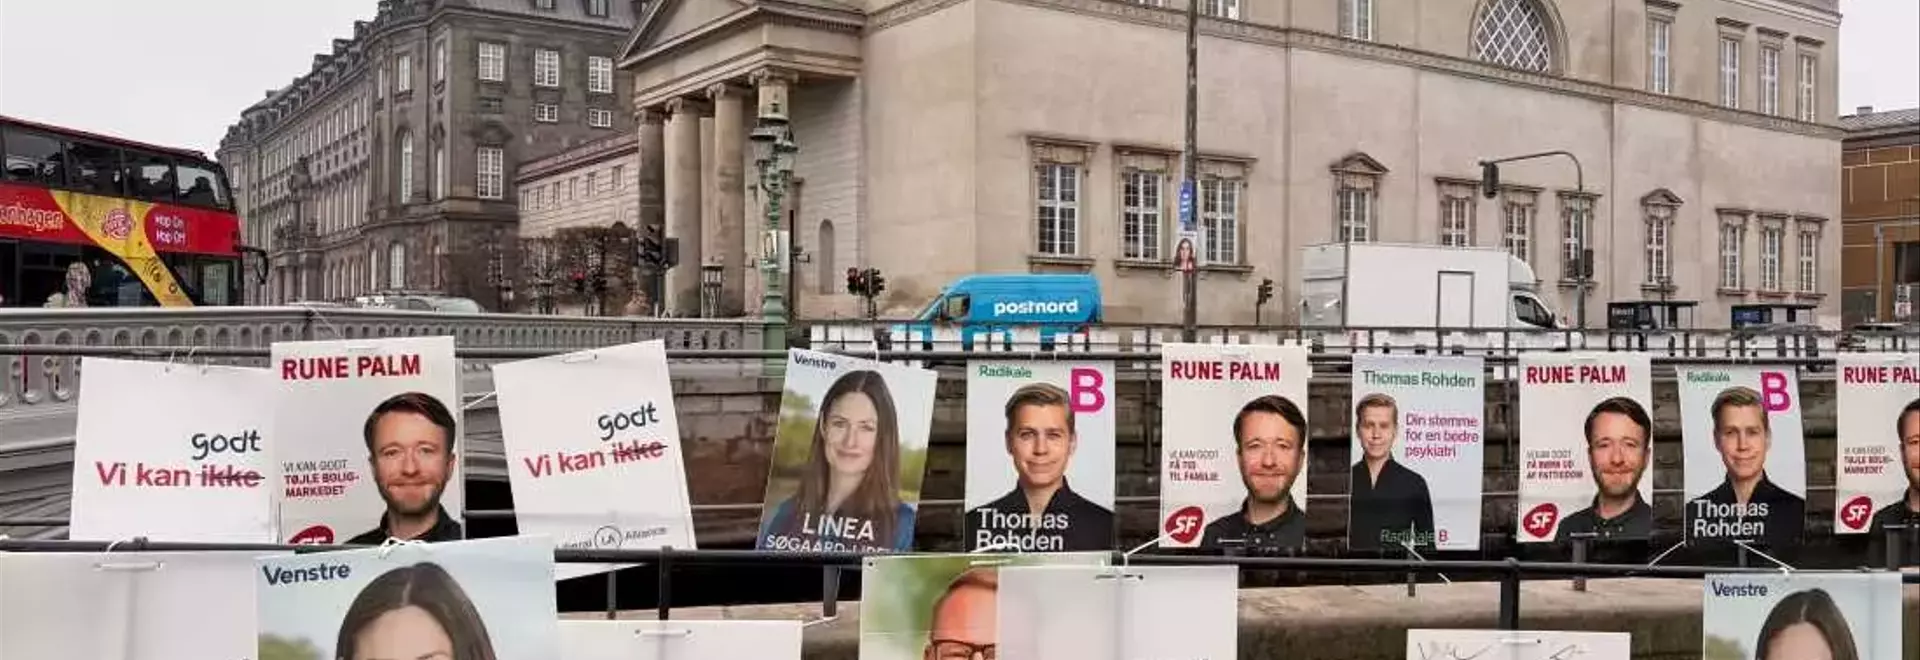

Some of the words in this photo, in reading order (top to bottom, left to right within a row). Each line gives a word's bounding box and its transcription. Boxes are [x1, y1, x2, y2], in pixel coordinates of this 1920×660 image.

[994, 299, 1078, 317] postnord
[282, 356, 350, 380] RUNE
[357, 354, 420, 377] PALM
[793, 352, 836, 370] Venstre
[980, 365, 1032, 378] Radikale
[1171, 360, 1223, 380] RUNE
[1229, 361, 1280, 381] PALM
[1362, 370, 1419, 385] Thomas
[1421, 372, 1476, 388] Rohden
[1526, 365, 1574, 384] RUNE
[1579, 364, 1626, 384] PALM
[1844, 366, 1888, 384] RUNE
[1070, 368, 1105, 412] B
[1761, 371, 1791, 412] B
[597, 400, 659, 441] godt
[1405, 413, 1426, 427] Din
[1428, 416, 1479, 428] stemme
[1405, 430, 1422, 441] for
[1425, 433, 1441, 441] en
[191, 430, 262, 461] godt
[1405, 445, 1456, 459] psykiatri
[284, 462, 294, 473] VI
[296, 461, 317, 472] KAN
[319, 459, 348, 471] GODT
[524, 453, 551, 478] Vi
[557, 450, 606, 474] kan
[609, 439, 668, 464] ikke
[96, 461, 127, 486] Vi
[136, 463, 191, 486] kan
[199, 464, 266, 488] ikke
[284, 473, 320, 485] TØJLE
[322, 471, 360, 483] BOLIG-
[285, 485, 345, 498] MARKEDET
[1693, 499, 1769, 518] Thomas
[1846, 505, 1868, 521] SF
[802, 512, 875, 541] LINEA
[976, 508, 1069, 529] Thomas
[1175, 516, 1198, 534] SF
[1530, 512, 1554, 529] SF
[1438, 529, 1449, 542] B
[1694, 518, 1765, 538] Rohden
[262, 563, 351, 586] Venstre
[1712, 580, 1768, 597] Venstre
